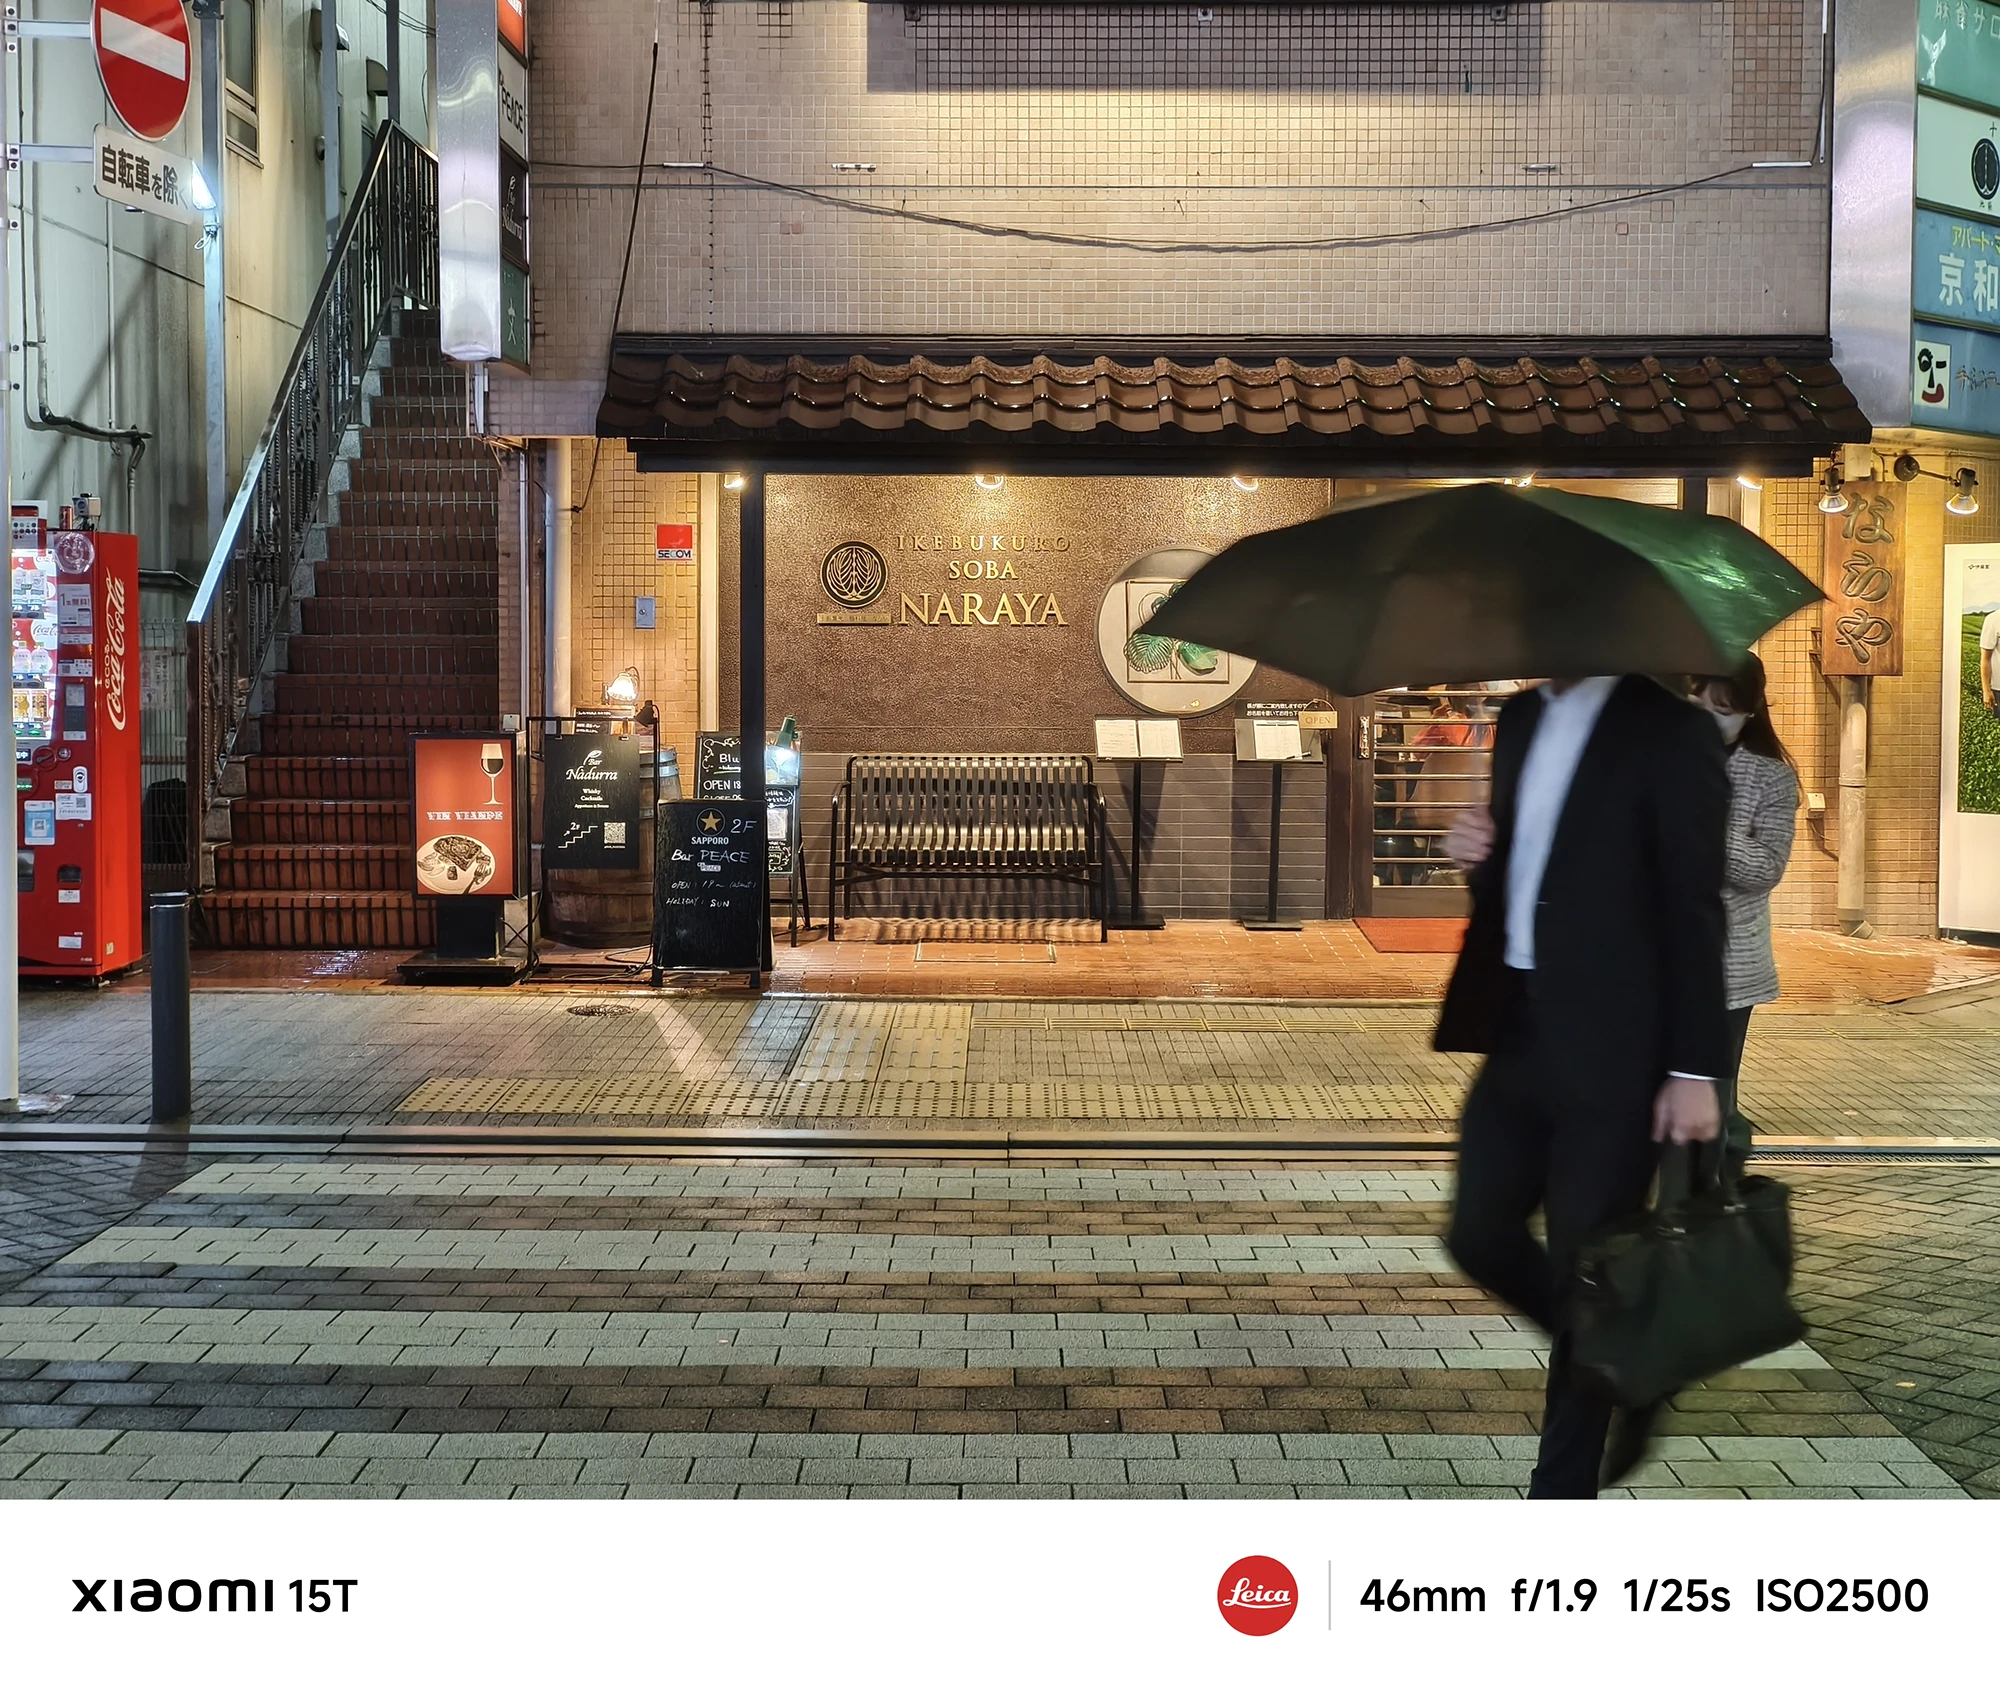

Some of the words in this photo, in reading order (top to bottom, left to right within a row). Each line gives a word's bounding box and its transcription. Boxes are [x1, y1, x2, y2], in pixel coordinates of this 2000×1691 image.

[102, 144, 188, 210] 自転車を除く
[897, 535, 1071, 551] IKEBUKURO
[657, 549, 692, 558] SECOM
[948, 560, 1018, 580] SOBA
[898, 592, 1069, 626] NARAYA
[106, 566, 126, 731] Coca-Cola
[1305, 716, 1331, 725] OPEN
[703, 780, 731, 790] OPEN
[730, 818, 758, 834] 2F
[691, 837, 730, 845] SAPPORO
[671, 849, 694, 861] Bar
[700, 849, 750, 863] PEACE
[709, 899, 730, 908] SUN
